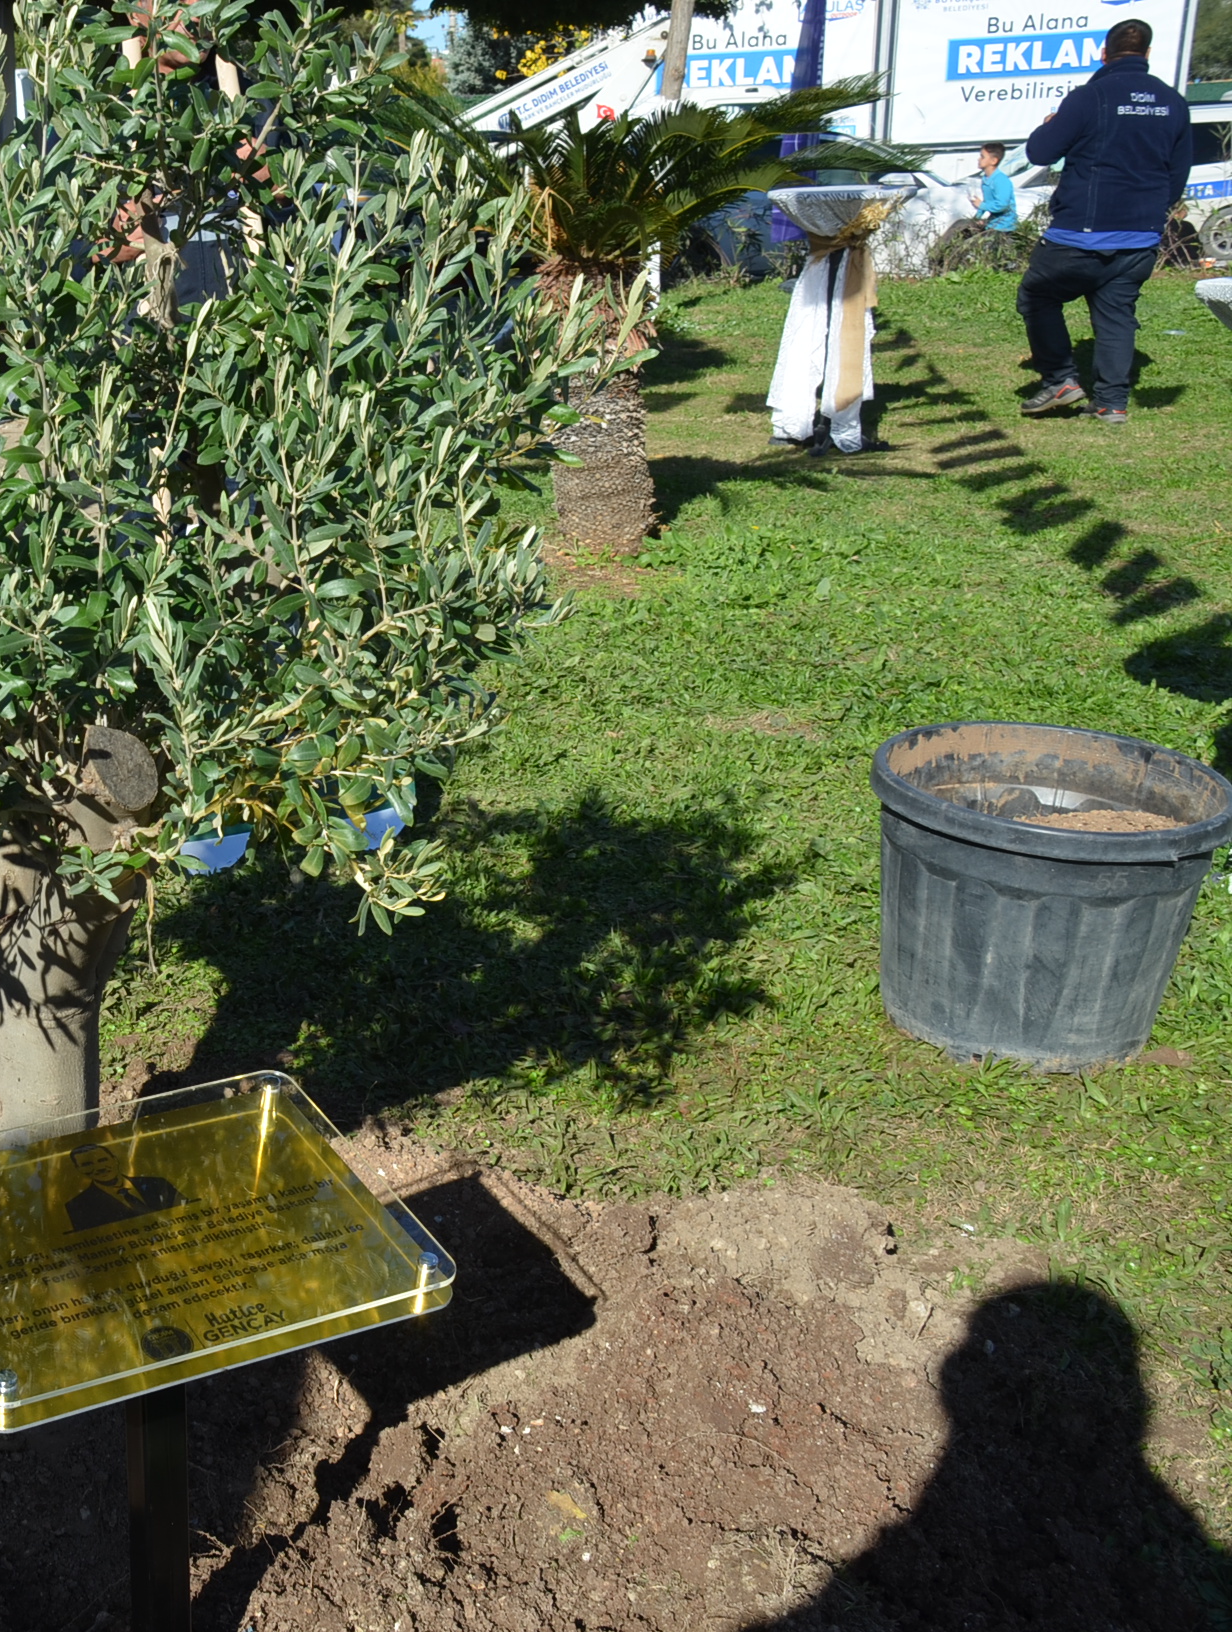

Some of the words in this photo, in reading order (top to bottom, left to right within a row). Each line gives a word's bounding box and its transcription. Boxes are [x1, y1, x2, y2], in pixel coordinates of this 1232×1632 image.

[987, 17, 1013, 34] Bu
[1022, 13, 1089, 31] Alana
[693, 34, 717, 50] Bu
[725, 31, 787, 49] Alana
[682, 54, 797, 88] EKLA
[516, 103, 532, 115] T.C.
[532, 88, 558, 107] DİDİM
[558, 61, 608, 93] BELEDİYESİ
[961, 80, 1079, 102] Verebilirsi
[1130, 92, 1156, 102] DİDİM
[1117, 105, 1169, 116] BELEDİYESİ
[201, 1206, 220, 1218] bir
[315, 1177, 334, 1189] bir
[206, 1209, 264, 1229] Belediye
[42, 1270, 80, 1286] Ferdi
[10, 1320, 58, 1340] geride
[127, 1290, 164, 1309] güzel
[32, 1302, 69, 1318] onun
[133, 1301, 181, 1320] devam
[204, 1302, 267, 1327] Hatice
[202, 1310, 287, 1343] GENÇAY
